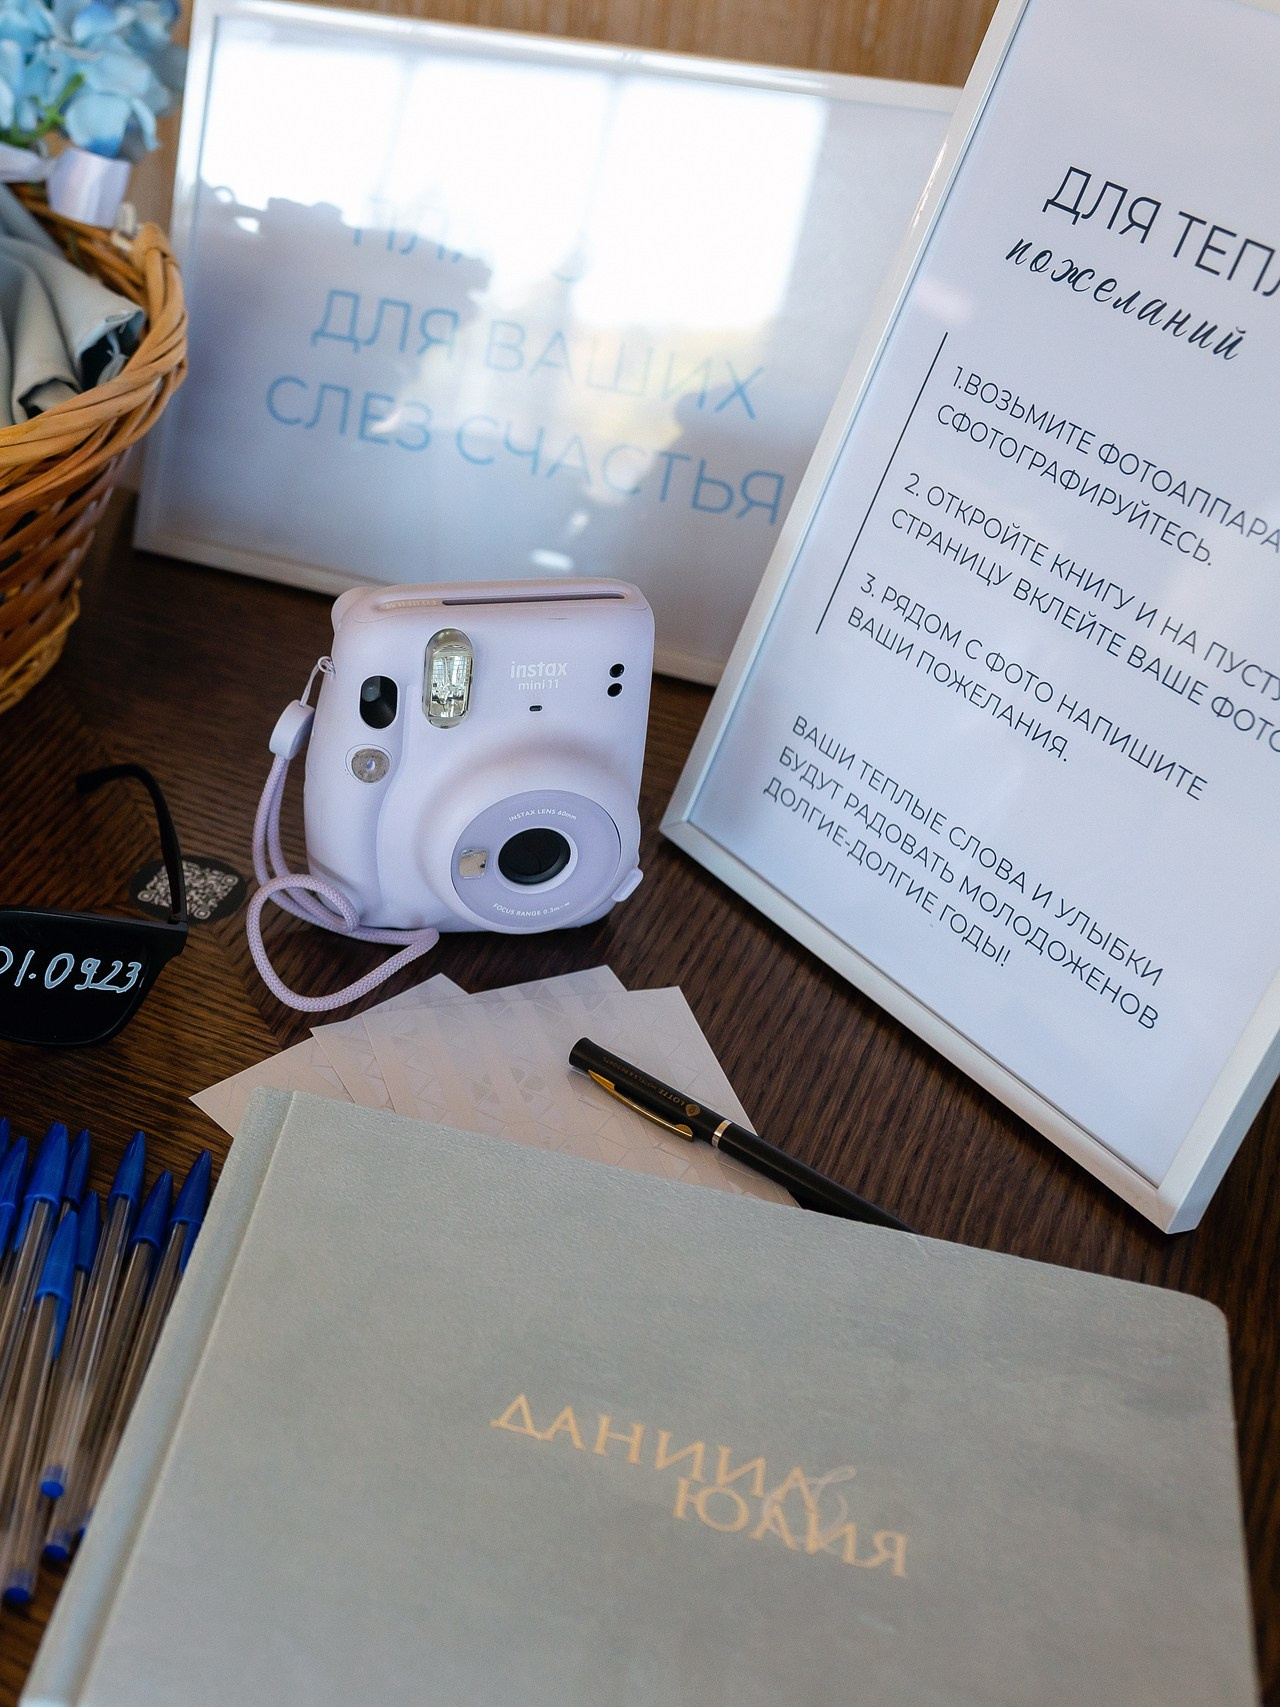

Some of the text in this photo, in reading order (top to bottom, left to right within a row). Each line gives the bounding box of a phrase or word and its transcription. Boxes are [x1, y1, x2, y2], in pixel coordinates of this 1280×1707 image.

[1041, 165, 1162, 244] ДЛЯ
[310, 289, 765, 420] ДЛЯ ВАШИХ
[1005, 238, 1246, 360] пожеланий
[266, 374, 786, 525] СЛЕЗ СЧАСТЬЯ
[937, 404, 1213, 567] СФОТОГРАФИРУЙТЕСЬ.
[891, 509, 1013, 587] СТРАНИЦУ
[1012, 578, 1127, 658] ВКЛЕЙТЕ
[1126, 645, 1209, 706] ВАШЕ
[904, 473, 919, 497] 2.
[927, 485, 1049, 567] ОТКРОЙТЕ
[1049, 553, 1136, 611] КНИГУ
[1135, 602, 1160, 629] И
[1159, 616, 1199, 655] НА
[510, 660, 569, 679] instax
[847, 607, 1069, 762] ВАШИ ПОЖЕЛАНИЯ.
[860, 573, 1208, 801] 3. РЯДОМ С ФОТО НАПИШИТЕ
[508, 808, 536, 822] INSTAX
[557, 810, 577, 821] 60mm
[763, 777, 1012, 967] ДОЛГИЕ-ДОЛГИЕ ГОДЫ!
[778, 745, 1159, 1030] БУДУТ РАДОВАТЬ МОЛОДОЖЕНОВ
[793, 715, 1164, 987] ВАШИ ТЕПЛЫЕ СЛОВА И УЛЫБКИ
[492, 903, 515, 915] FOCUS
